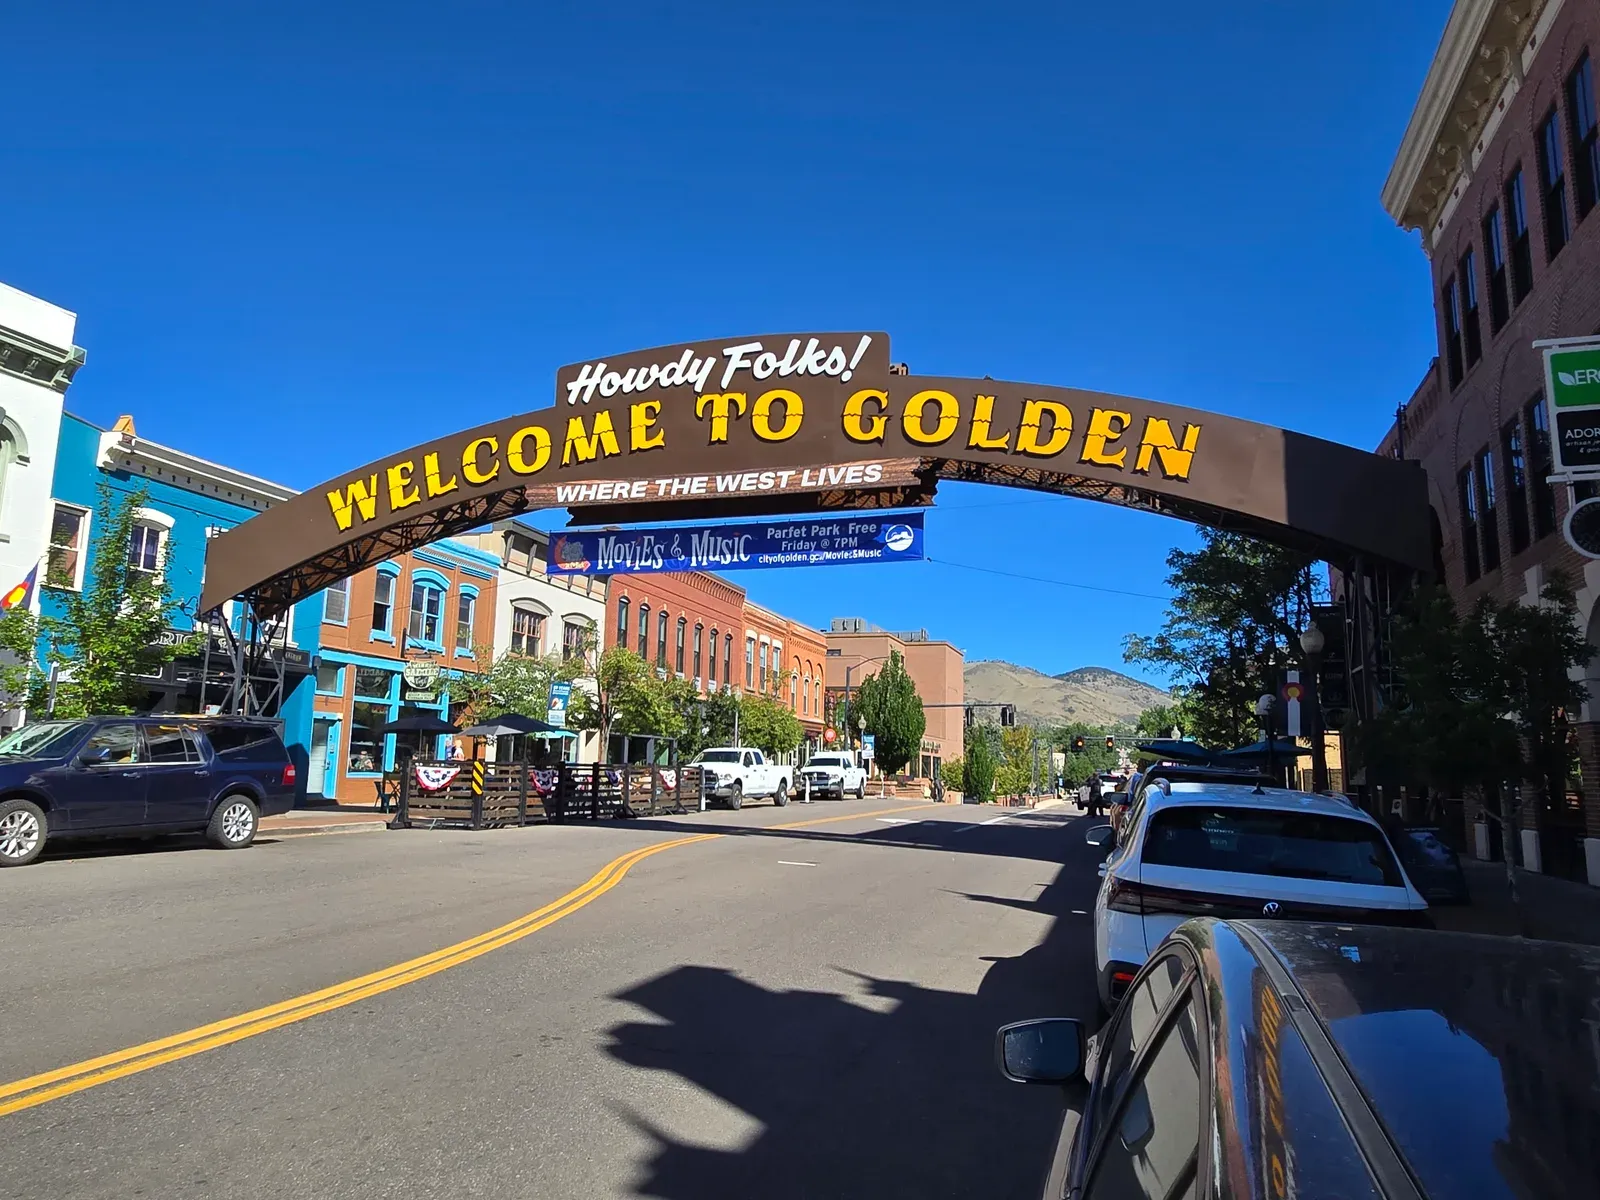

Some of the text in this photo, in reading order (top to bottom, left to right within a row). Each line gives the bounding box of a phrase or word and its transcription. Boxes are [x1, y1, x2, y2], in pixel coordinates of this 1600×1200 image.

[566, 334, 873, 405] Howdy Folks!
[1574, 368, 1600, 385] ER
[326, 388, 1201, 531] WELCOME TO GOLDEN
[556, 464, 883, 503] WHERE THE WEST LIVES
[767, 522, 877, 539] Parfet Park Free
[781, 536, 858, 553] Friday @ 7PM
